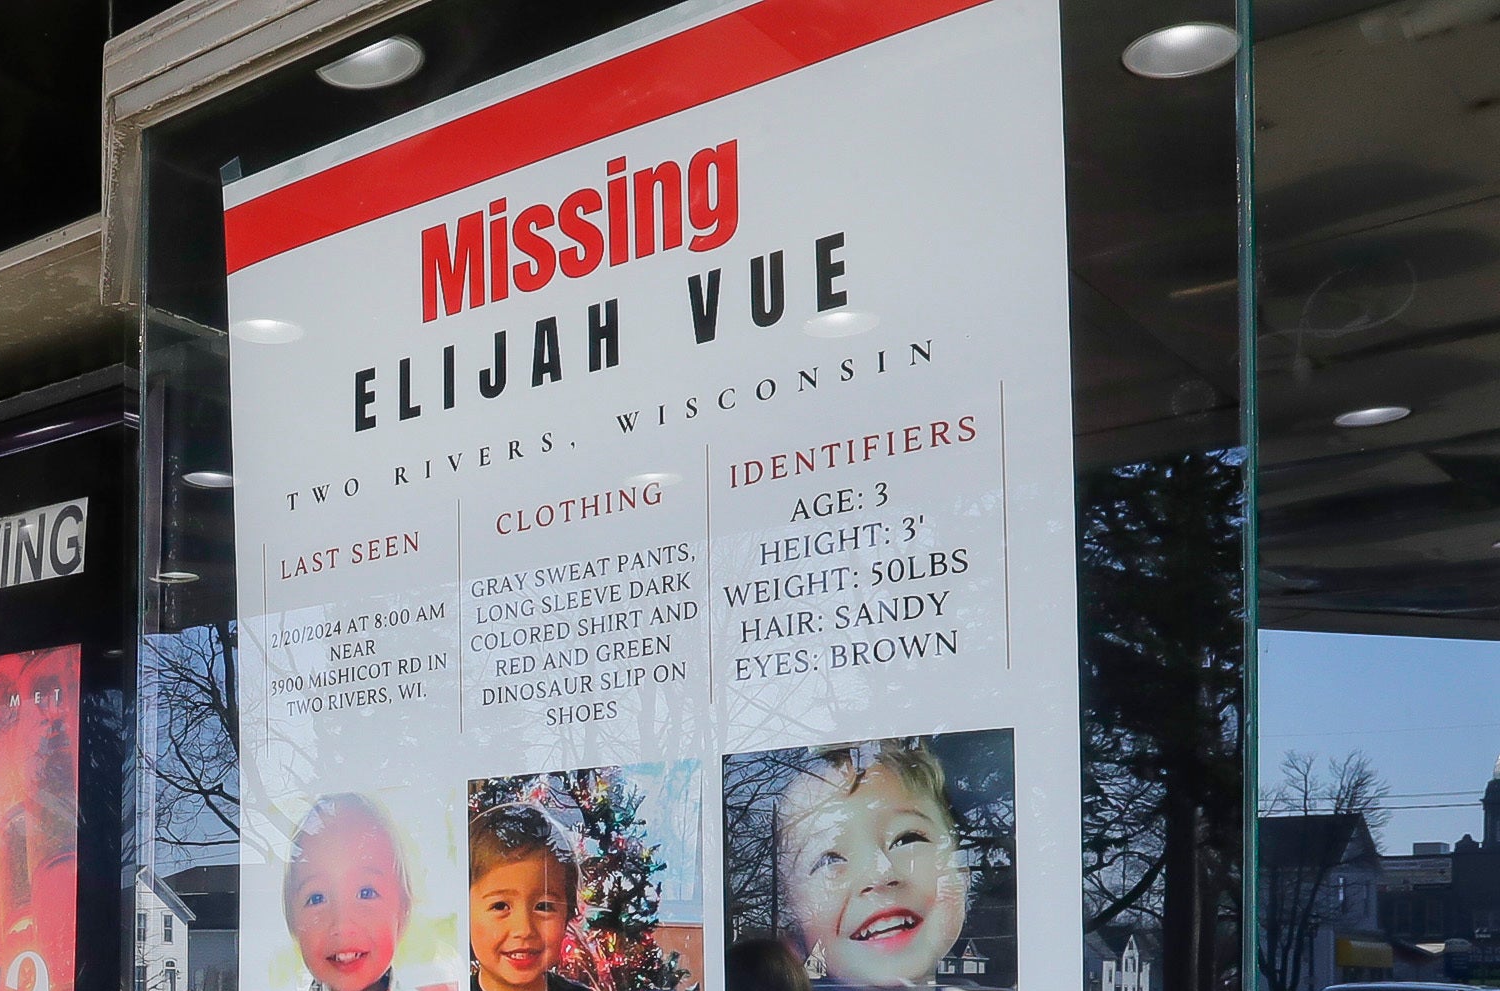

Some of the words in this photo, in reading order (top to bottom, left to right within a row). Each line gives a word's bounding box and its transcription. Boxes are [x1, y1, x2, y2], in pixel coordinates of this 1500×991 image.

[421, 139, 739, 324] Missing
[354, 298, 620, 432] ELIJAH
[688, 232, 847, 344] VUE
[287, 477, 360, 511] TWO
[394, 432, 577, 486] RIVERS,
[616, 340, 933, 435] WISCONSIN
[730, 416, 977, 489] IDENTIFIERS
[496, 482, 662, 536] CLOTHING
[790, 489, 863, 522] AGE:
[875, 482, 888, 507] 3
[281, 548, 340, 580] LAST
[352, 531, 420, 564] SEEN
[760, 523, 890, 566] HEIGHT:
[902, 515, 924, 542] 3'
[471, 572, 528, 598] GRAY
[534, 558, 610, 588] SWEAT
[618, 543, 696, 573] PANTS,
[723, 567, 859, 608] WEIGHT:
[871, 549, 969, 586] 50LBS
[476, 599, 535, 624] LONG
[541, 584, 621, 614] SLEEVE
[629, 572, 691, 599] DARK
[740, 611, 823, 644] HAIR:
[835, 591, 950, 630] SANDY
[271, 621, 342, 649] 2/20/2024
[346, 615, 370, 634] AT
[374, 608, 410, 629] 8:00
[416, 602, 446, 622] AM
[330, 640, 376, 661] NEAR
[470, 622, 570, 652] COLORED
[578, 609, 643, 636] SHIRT
[649, 601, 698, 626] AND
[271, 676, 304, 696] 3900
[308, 662, 392, 689] MISHICOT
[398, 657, 422, 675] RD
[428, 653, 447, 670] IN
[495, 655, 536, 677] RED
[542, 648, 588, 671] AND
[596, 634, 671, 662] GREEN
[735, 649, 818, 682] EYES:
[830, 630, 958, 669] BROWN
[287, 697, 323, 716] TWO
[328, 687, 392, 711] RIVERS,
[398, 682, 427, 700] WI.
[482, 675, 593, 706] DINOSAUR
[600, 668, 646, 691] SLIP
[653, 661, 687, 683] ON
[546, 701, 618, 726] SHOES
